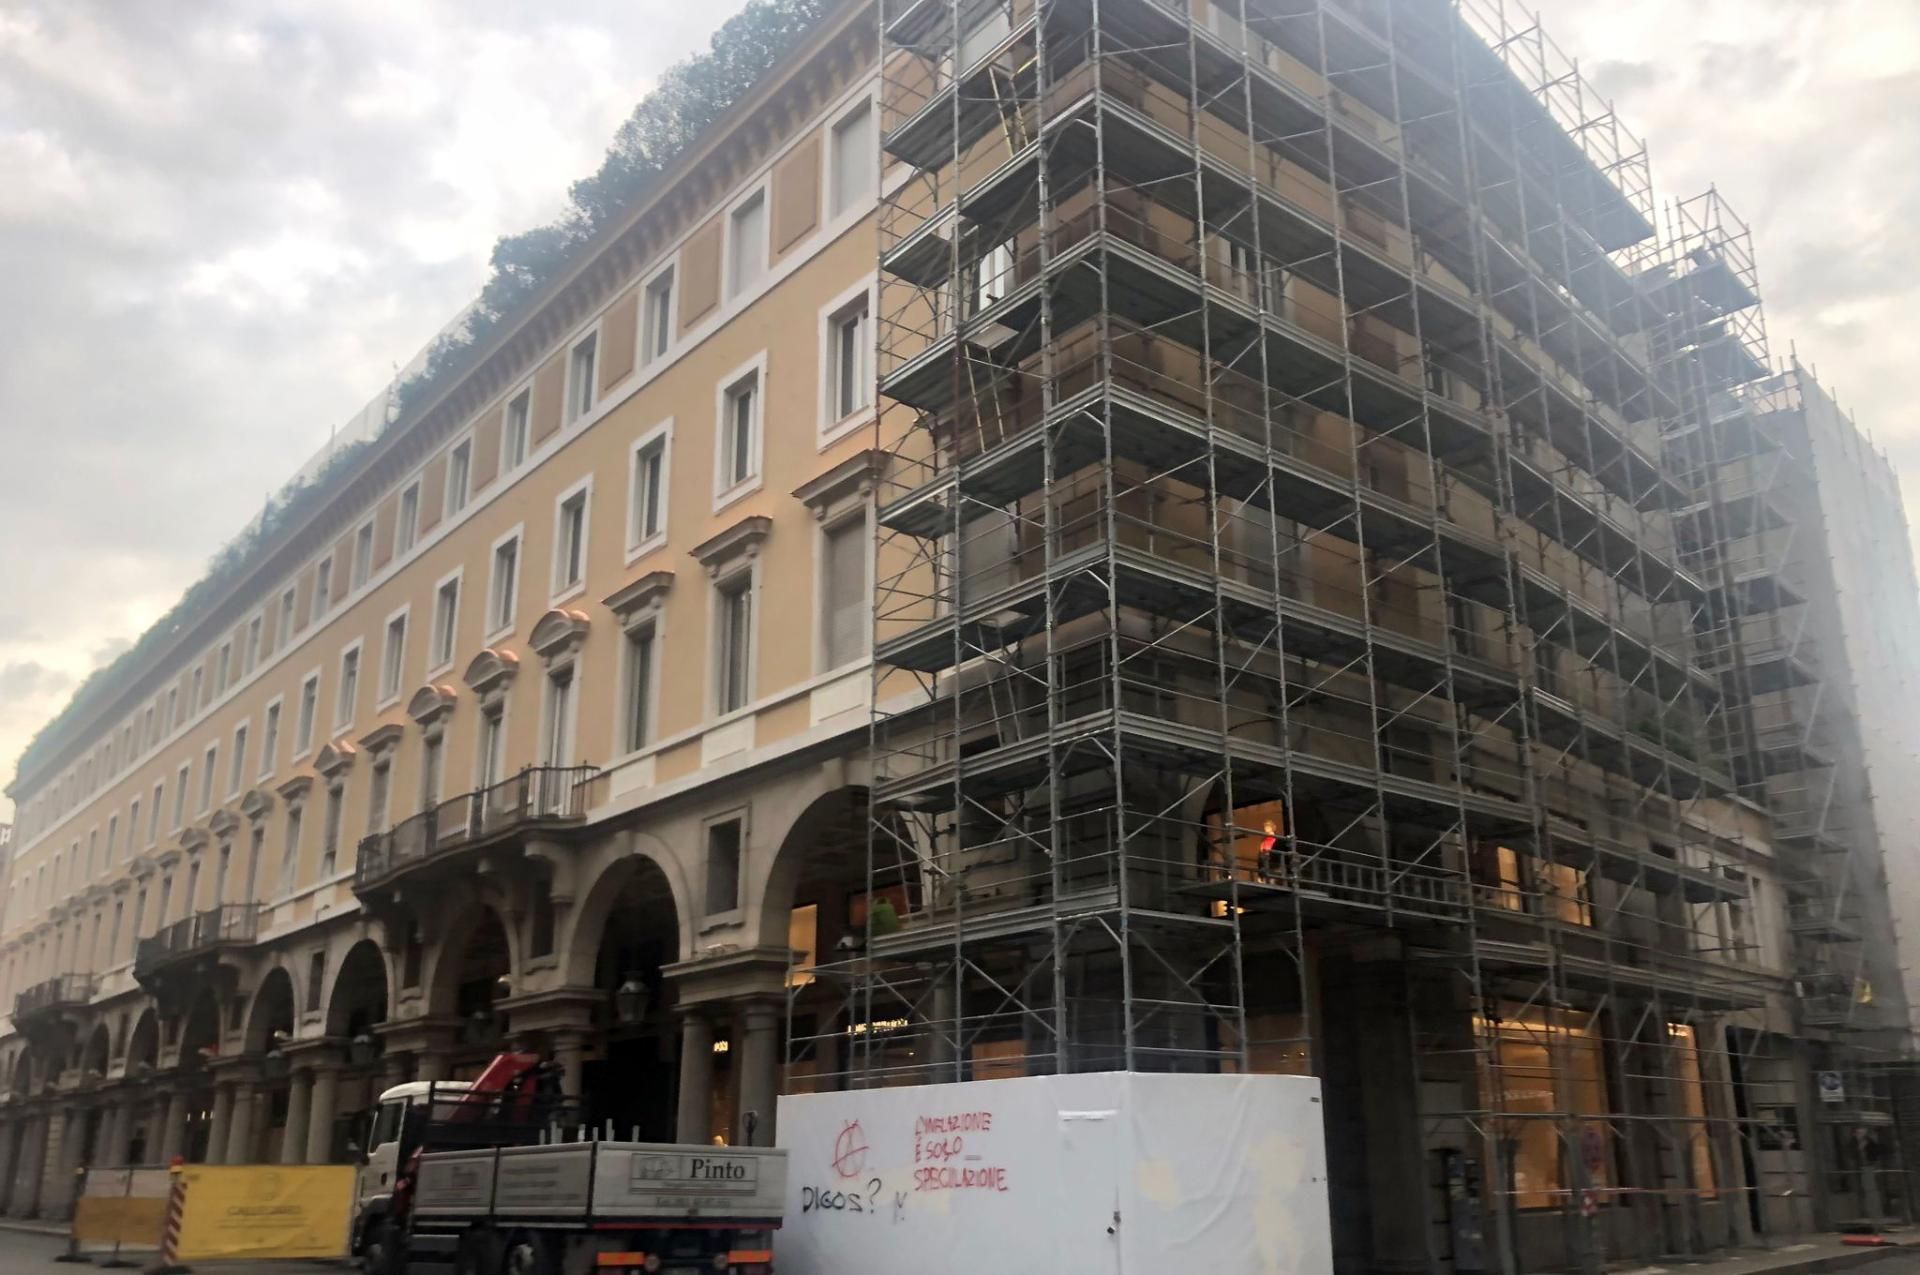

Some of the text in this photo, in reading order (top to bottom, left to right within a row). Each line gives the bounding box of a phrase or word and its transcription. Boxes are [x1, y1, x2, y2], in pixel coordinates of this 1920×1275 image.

[926, 1135, 963, 1162] SOLO
[690, 1158, 745, 1179] Pinto
[913, 1166, 1008, 1192] SPECULAZIONE
[802, 1178, 882, 1214] DIGOS?
